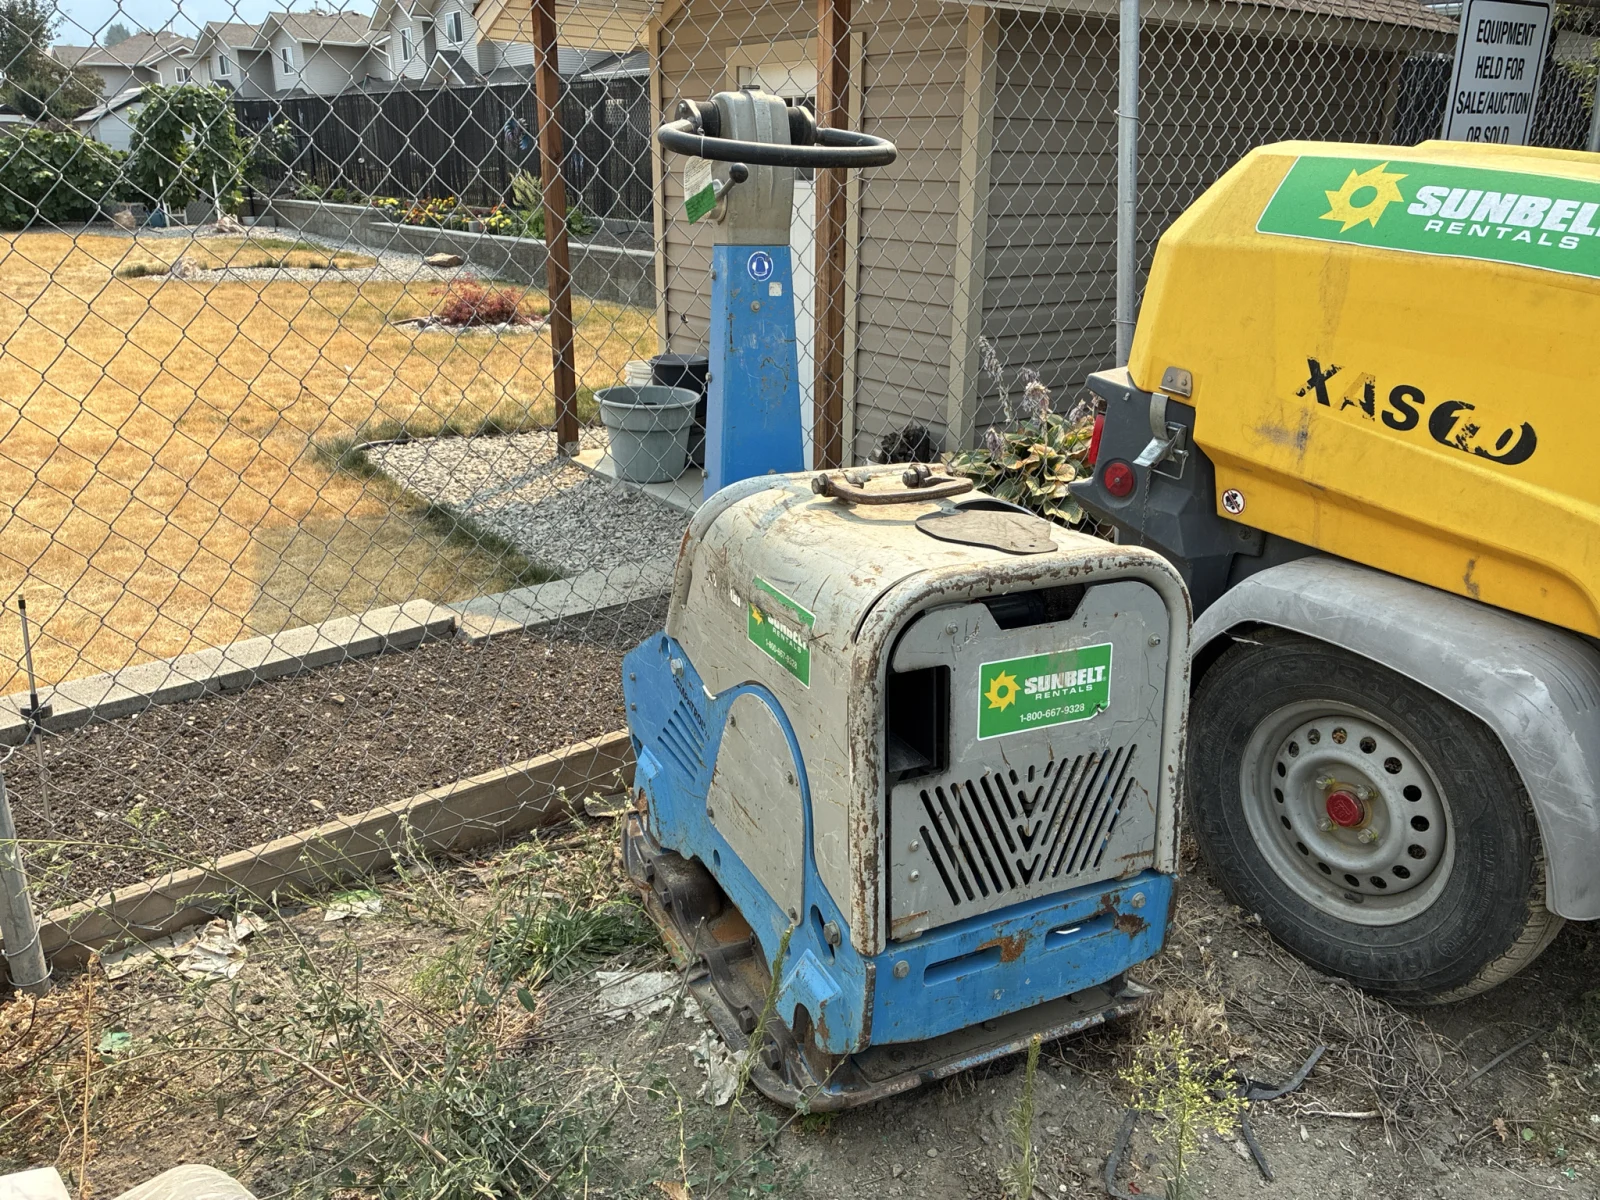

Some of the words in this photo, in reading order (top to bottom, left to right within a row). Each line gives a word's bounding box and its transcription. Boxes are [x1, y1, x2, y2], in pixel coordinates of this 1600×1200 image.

[1476, 19, 1537, 46] EQUIPMENT
[1475, 56, 1504, 80] HELD
[1504, 57, 1526, 81] FOR
[1456, 91, 1531, 115] SALE/AUCTION
[1466, 126, 1481, 142] OR
[1407, 185, 1600, 237] SUNBEL
[1424, 219, 1580, 250] RENTALS
[772, 627, 802, 654] RENTALS
[1024, 665, 1106, 695] SUNBELT
[1035, 684, 1093, 701] RENTALS
[1019, 703, 1085, 723] 1-800-667-9328
